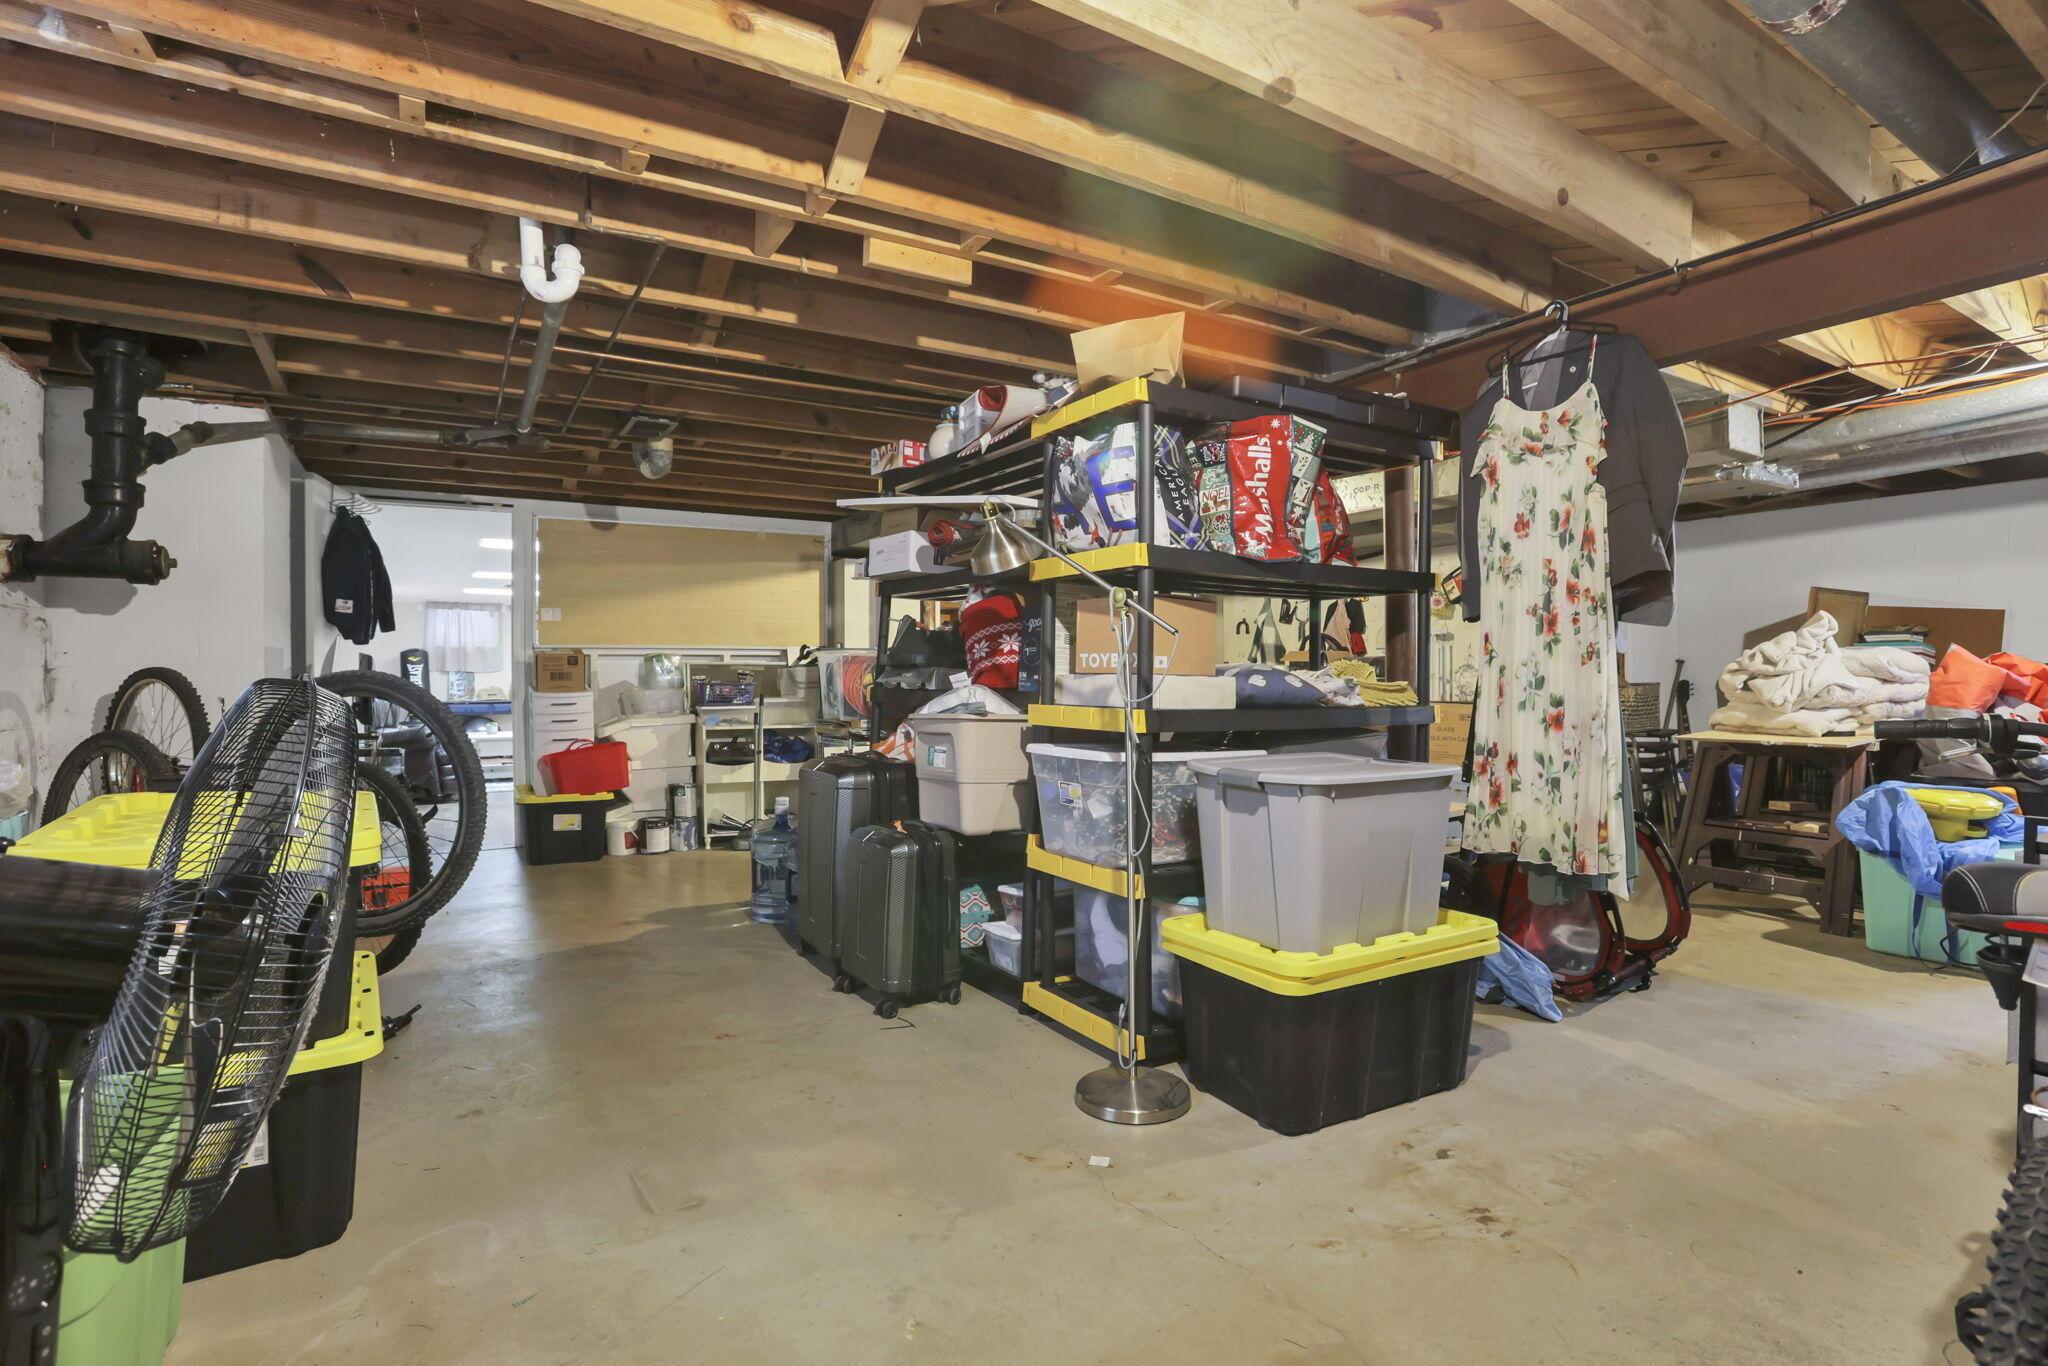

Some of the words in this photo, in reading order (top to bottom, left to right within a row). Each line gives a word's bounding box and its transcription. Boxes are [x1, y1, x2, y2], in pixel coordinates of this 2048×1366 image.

[1155, 447, 1186, 522] AMERICAN
[1202, 486, 1230, 501] NOEL
[1244, 436, 1274, 543] Marshalls
[1080, 652, 1138, 668] TOYB
